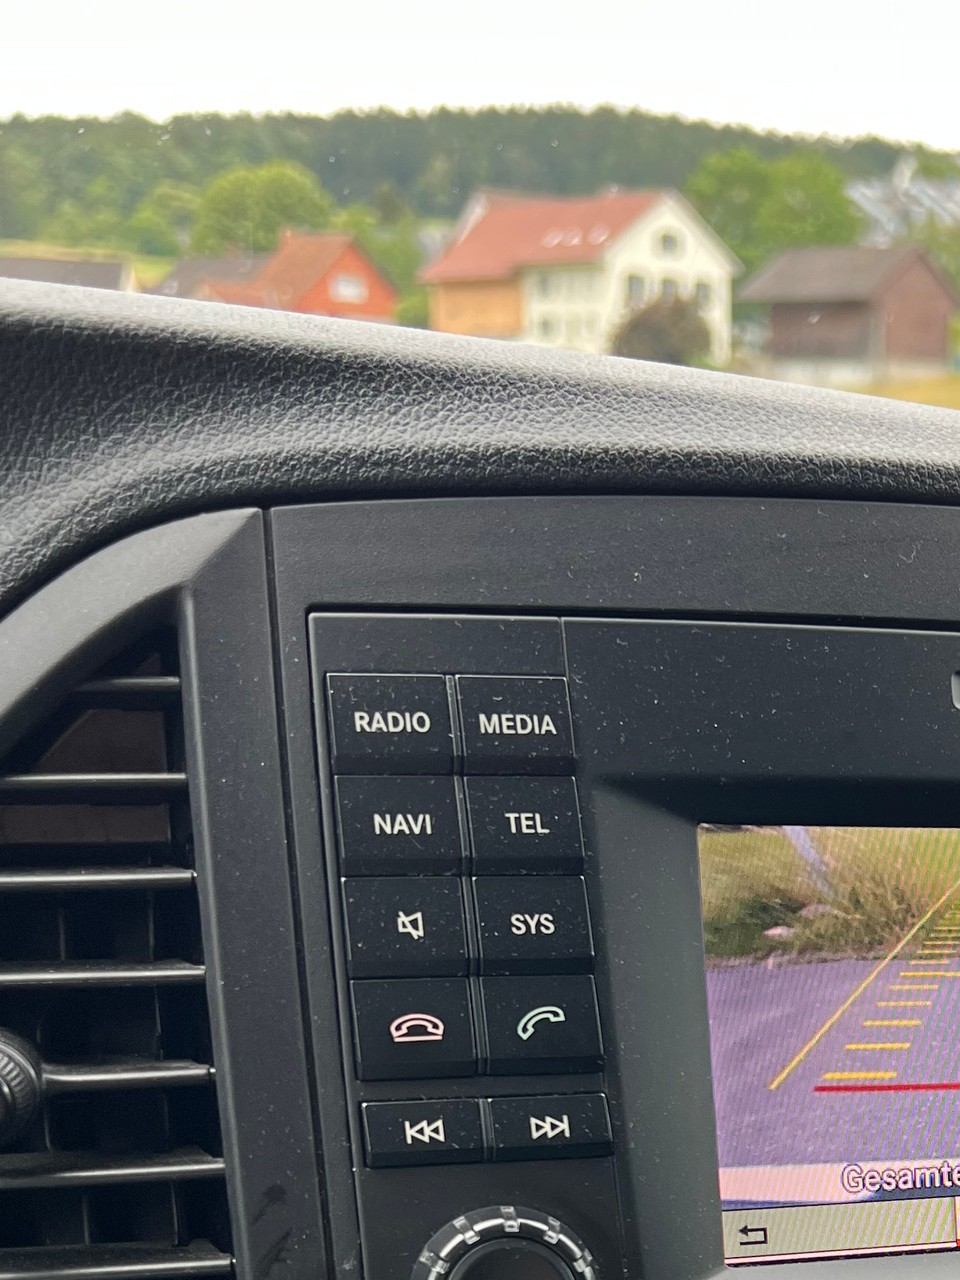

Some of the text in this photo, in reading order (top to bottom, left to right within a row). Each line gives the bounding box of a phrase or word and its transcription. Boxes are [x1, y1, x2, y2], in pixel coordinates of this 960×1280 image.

[353, 710, 432, 734] RADIO
[478, 713, 558, 737] MEDIA
[373, 813, 433, 835] NAVI
[504, 812, 550, 835] TEL
[510, 913, 556, 935] SYS
